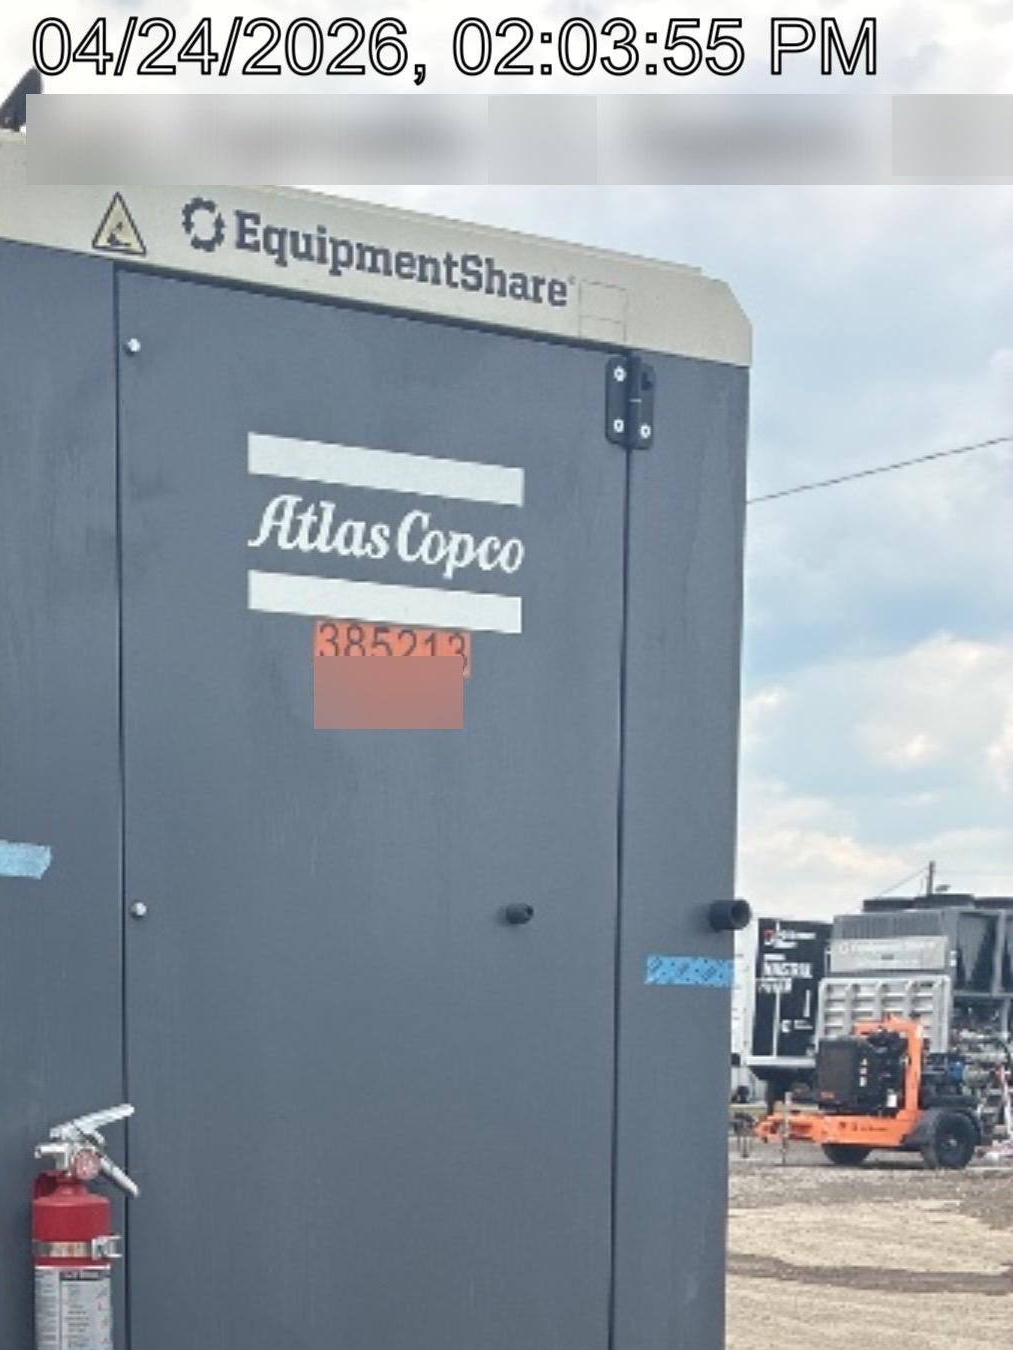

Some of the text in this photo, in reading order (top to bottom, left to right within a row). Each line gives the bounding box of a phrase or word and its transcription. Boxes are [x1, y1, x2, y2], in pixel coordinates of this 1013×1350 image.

[234, 208, 569, 307] EquipmentShare
[247, 494, 525, 580] Atlas Copco
